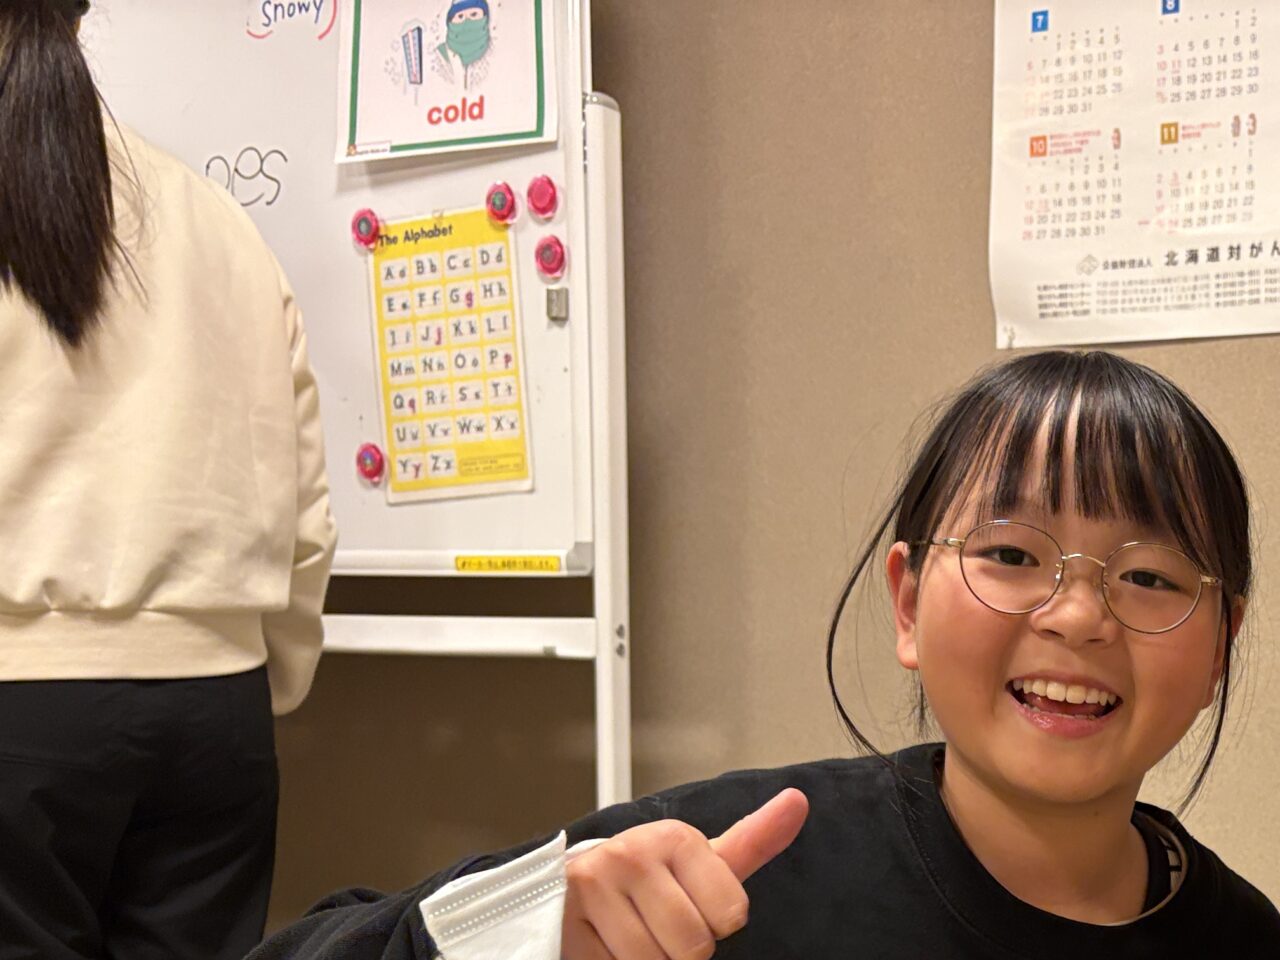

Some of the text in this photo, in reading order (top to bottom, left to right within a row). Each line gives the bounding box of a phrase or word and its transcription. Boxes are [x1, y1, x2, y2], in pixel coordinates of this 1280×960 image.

[1165, 0, 1176, 10] 8
[1035, 14, 1044, 29] 7
[427, 95, 485, 126] cold
[1162, 126, 1175, 142] 11
[1032, 139, 1044, 155] 10
[378, 225, 453, 247] The Alphabet
